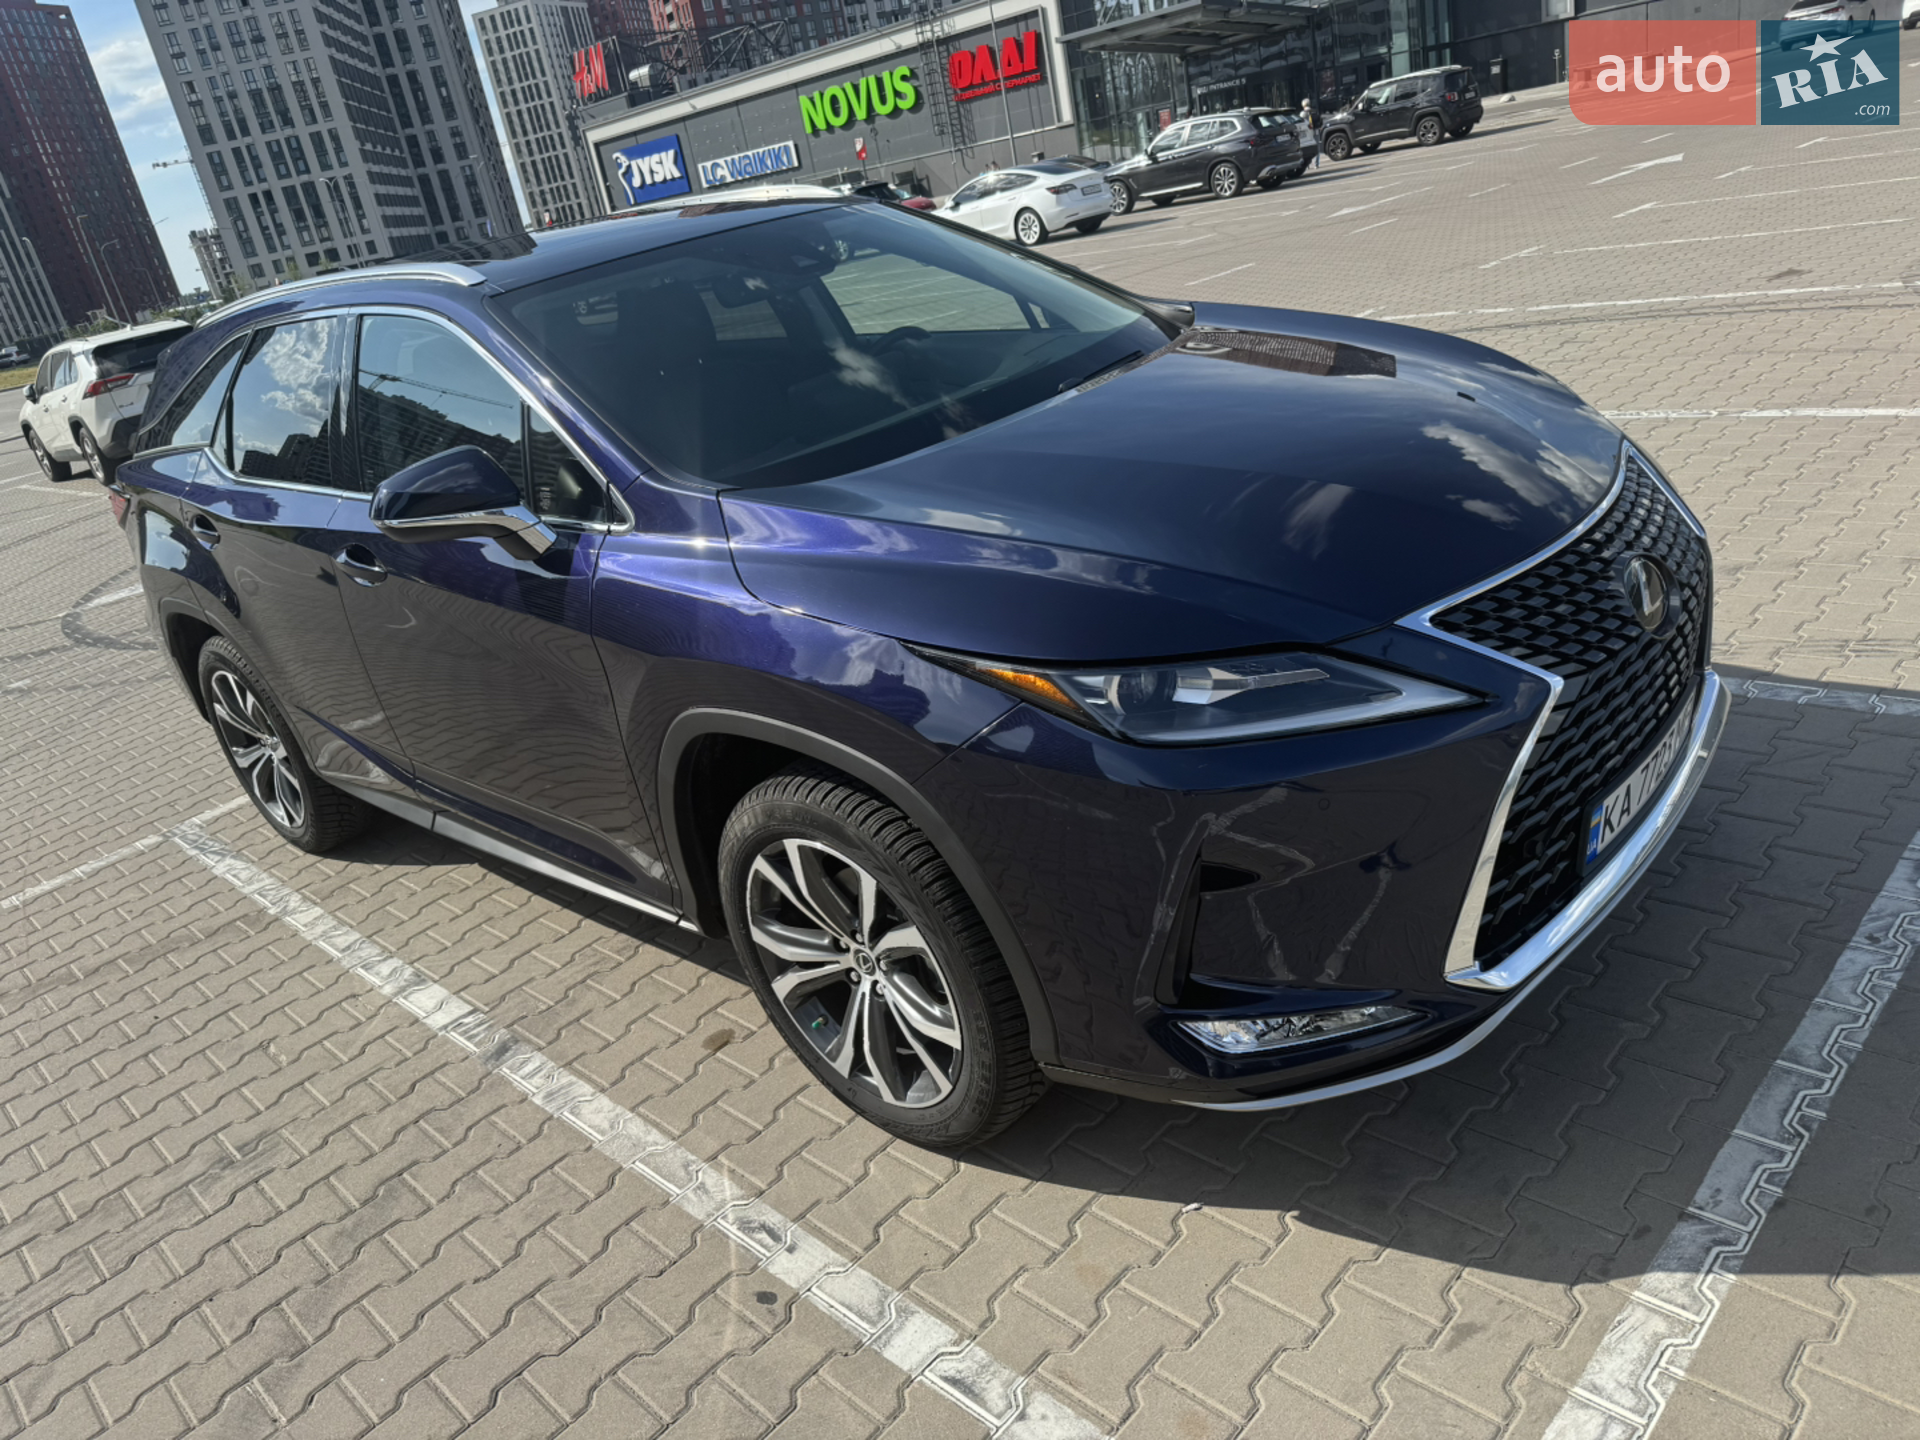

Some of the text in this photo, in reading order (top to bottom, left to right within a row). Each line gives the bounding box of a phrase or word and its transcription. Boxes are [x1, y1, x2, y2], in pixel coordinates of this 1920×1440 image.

[799, 65, 916, 134] NOVUS
[995, 72, 1042, 91] СПЕРМАРКЕТ
[630, 149, 683, 188] JYSK
[702, 162, 726, 186] LC
[1601, 783, 1632, 845] KA
